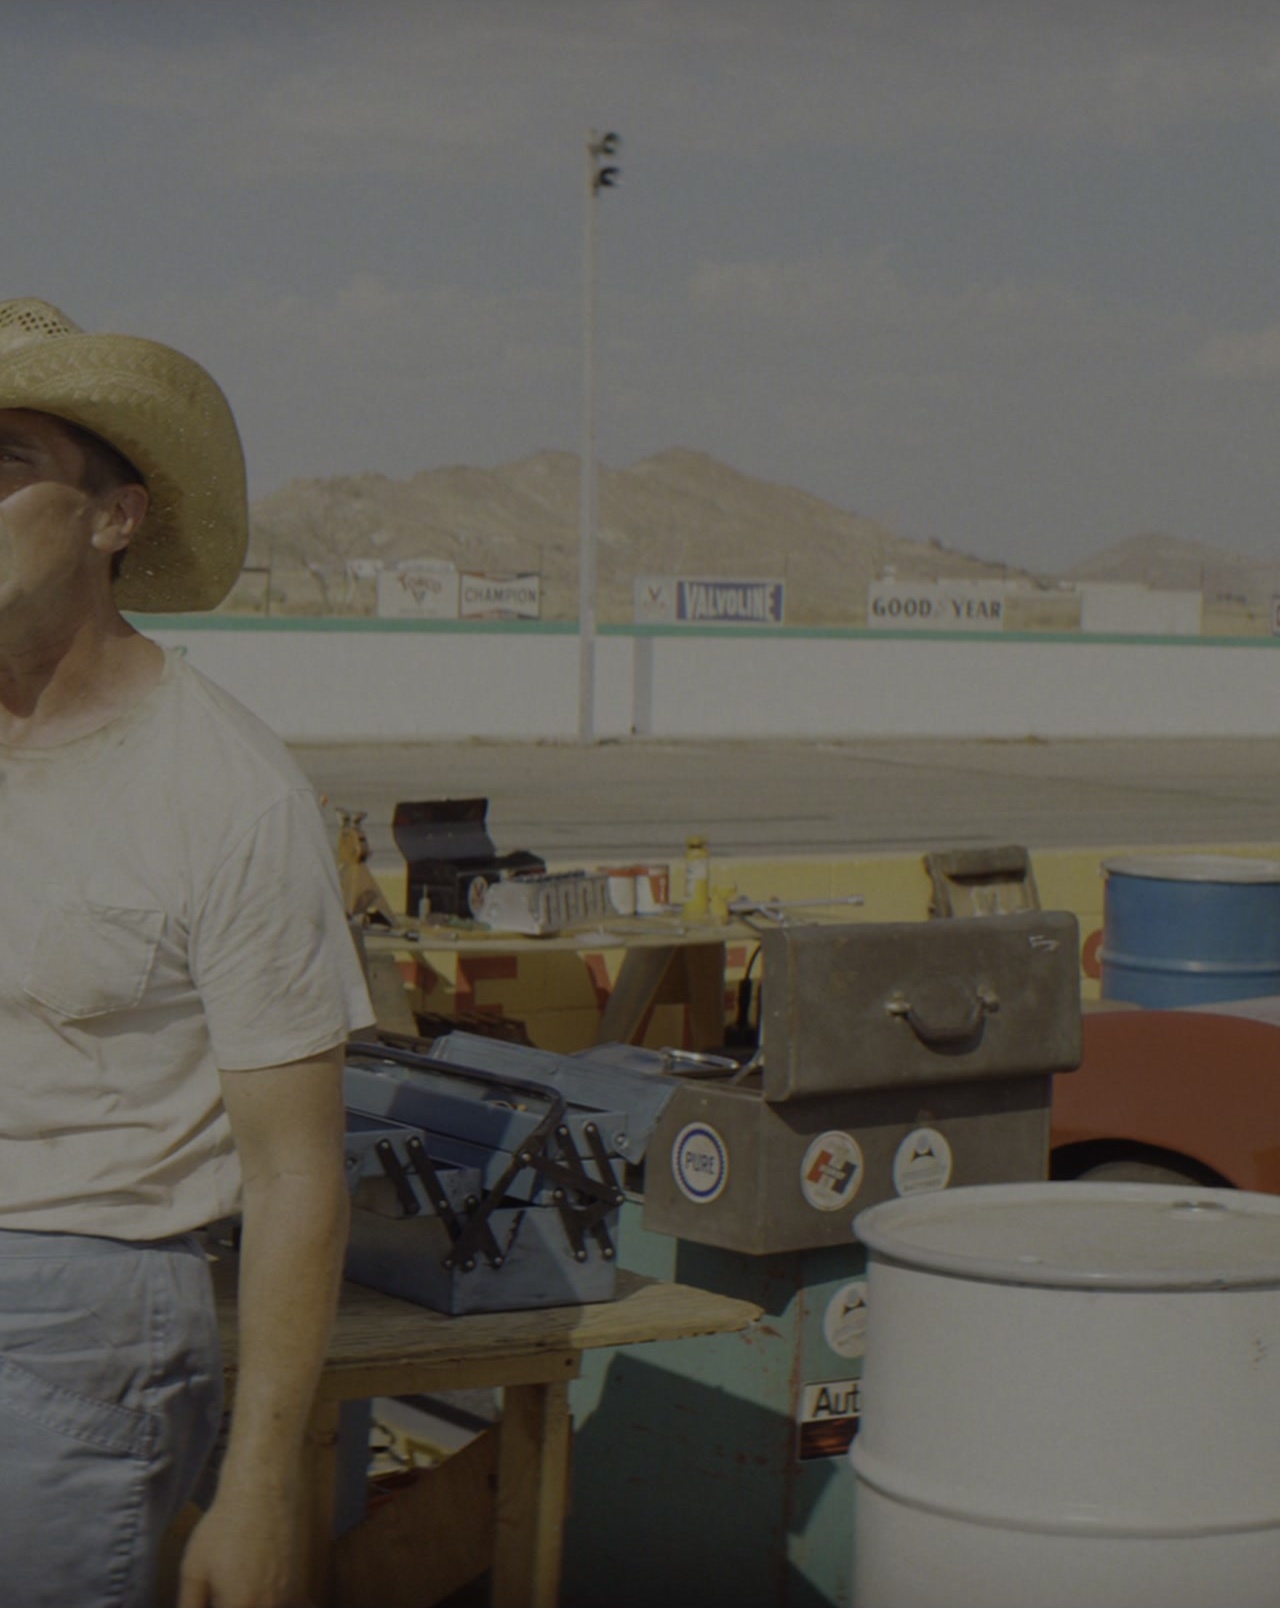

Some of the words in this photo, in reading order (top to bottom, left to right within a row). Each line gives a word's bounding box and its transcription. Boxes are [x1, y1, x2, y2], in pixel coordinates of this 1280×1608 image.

[464, 585, 538, 604] CHAMPION
[684, 583, 777, 621] VALVOLINE
[872, 597, 932, 618] GOOD
[951, 598, 1002, 619] YEAR
[685, 1152, 715, 1175] PURE
